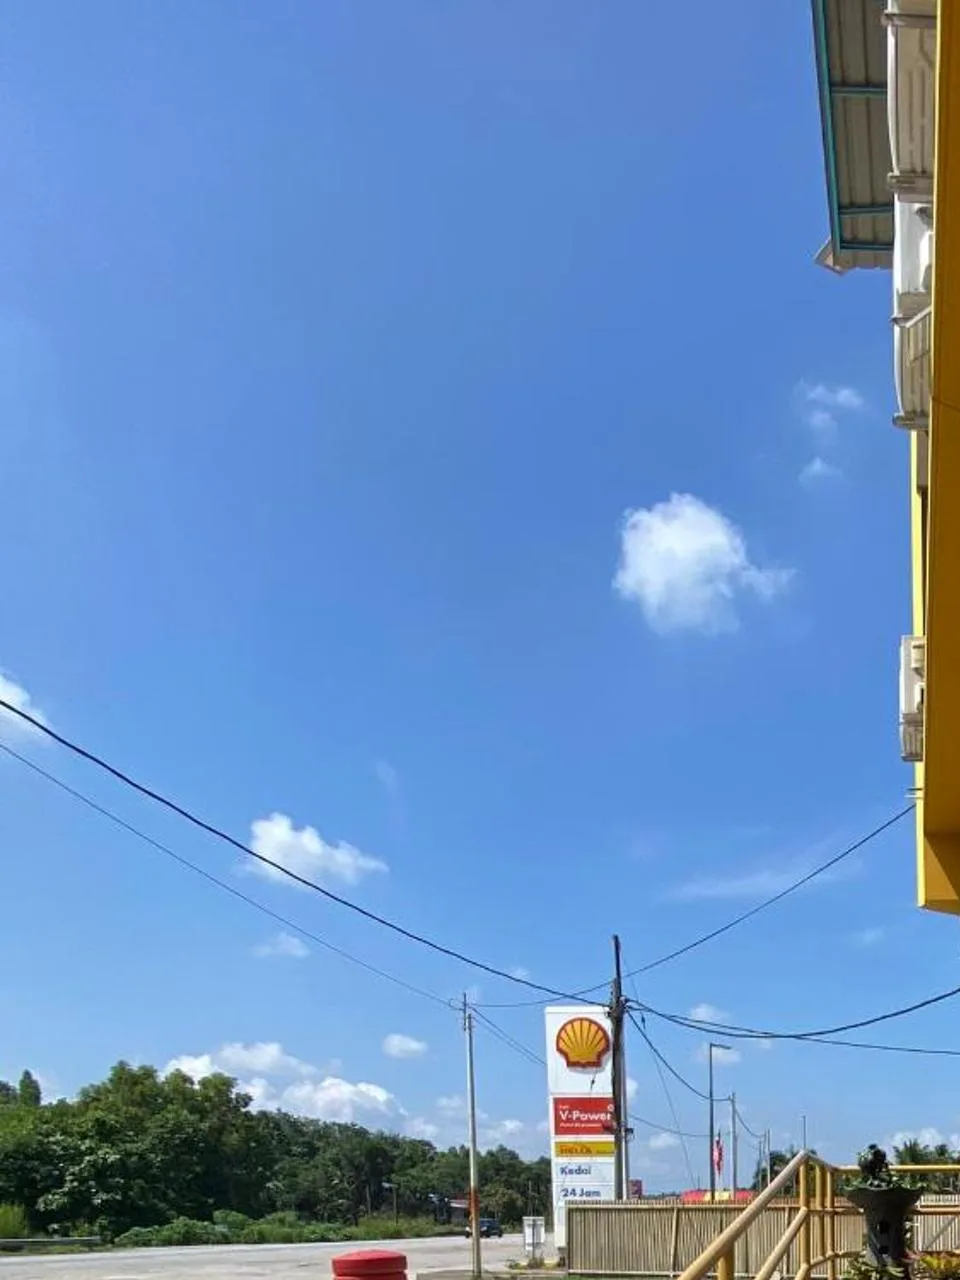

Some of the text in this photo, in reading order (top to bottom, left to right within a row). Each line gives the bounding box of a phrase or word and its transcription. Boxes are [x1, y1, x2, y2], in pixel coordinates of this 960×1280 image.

[560, 1110, 611, 1121] V-Power
[560, 1164, 592, 1175] Kedai
[560, 1187, 602, 1197] 24 Jam
